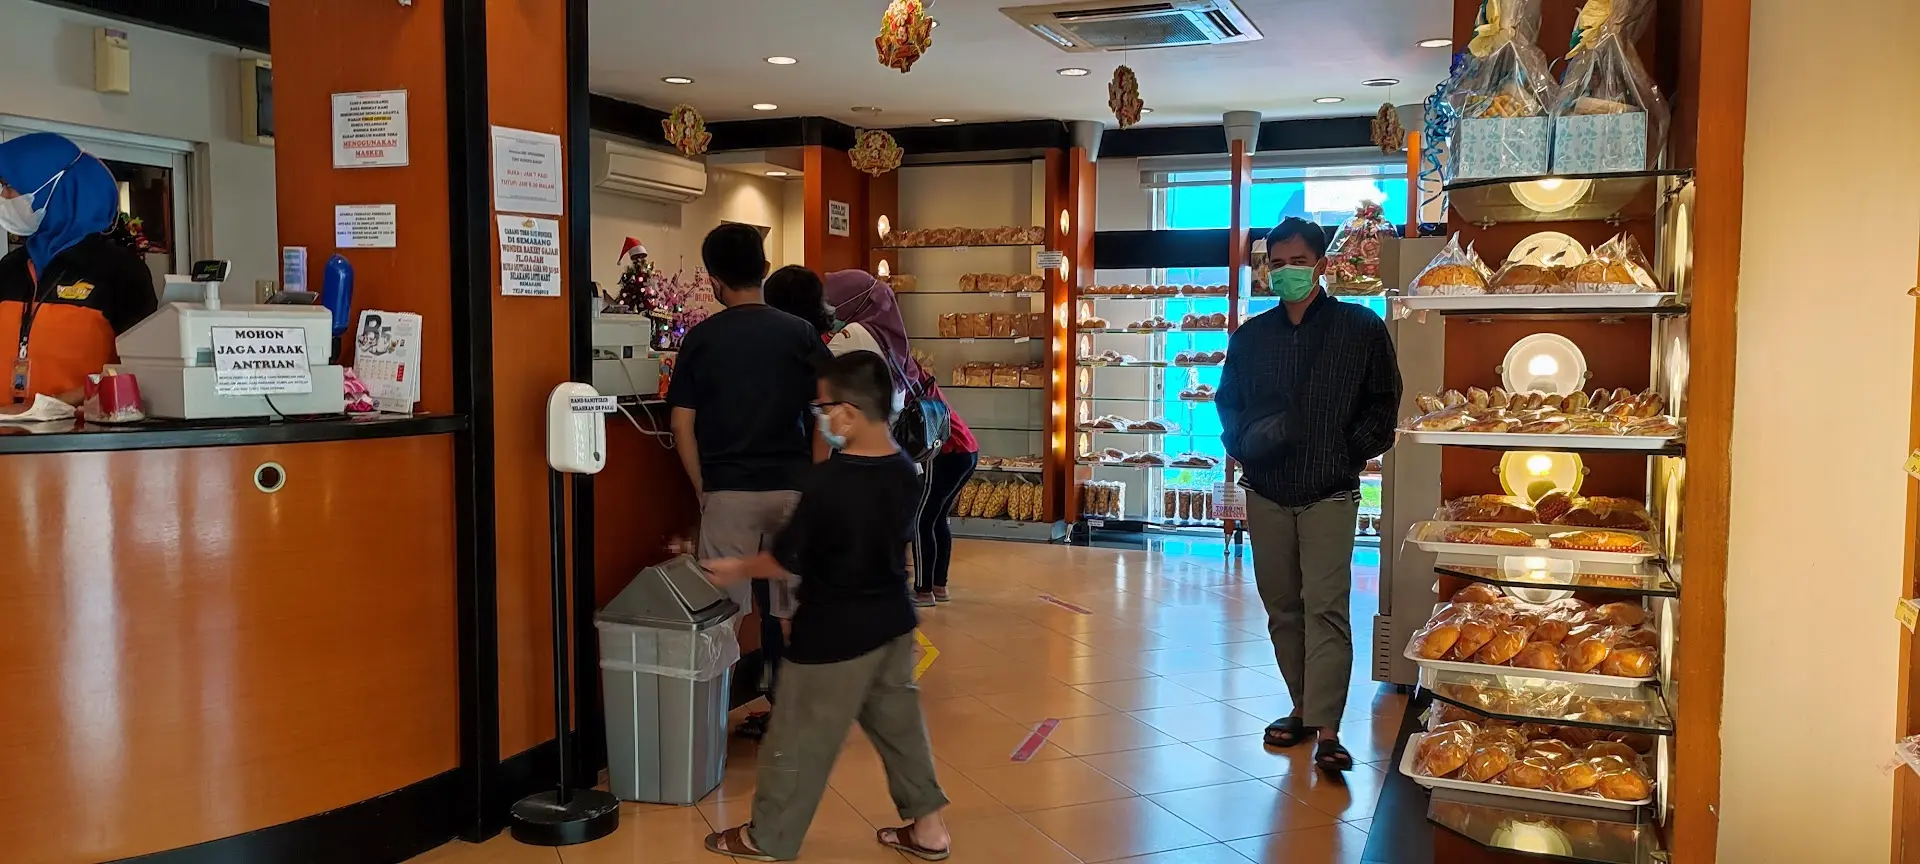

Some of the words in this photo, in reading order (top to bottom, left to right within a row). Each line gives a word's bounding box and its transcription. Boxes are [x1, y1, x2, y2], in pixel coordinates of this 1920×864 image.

[343, 140, 397, 148] MENGGUNAKAN
[516, 237, 551, 246] SEMARANG
[502, 244, 522, 253] WONDER
[524, 246, 540, 254] BAKERY
[235, 330, 284, 339] MOHON
[218, 345, 256, 354] JAGA
[259, 345, 304, 354] JARAK
[232, 360, 294, 370] ANTRIAN
